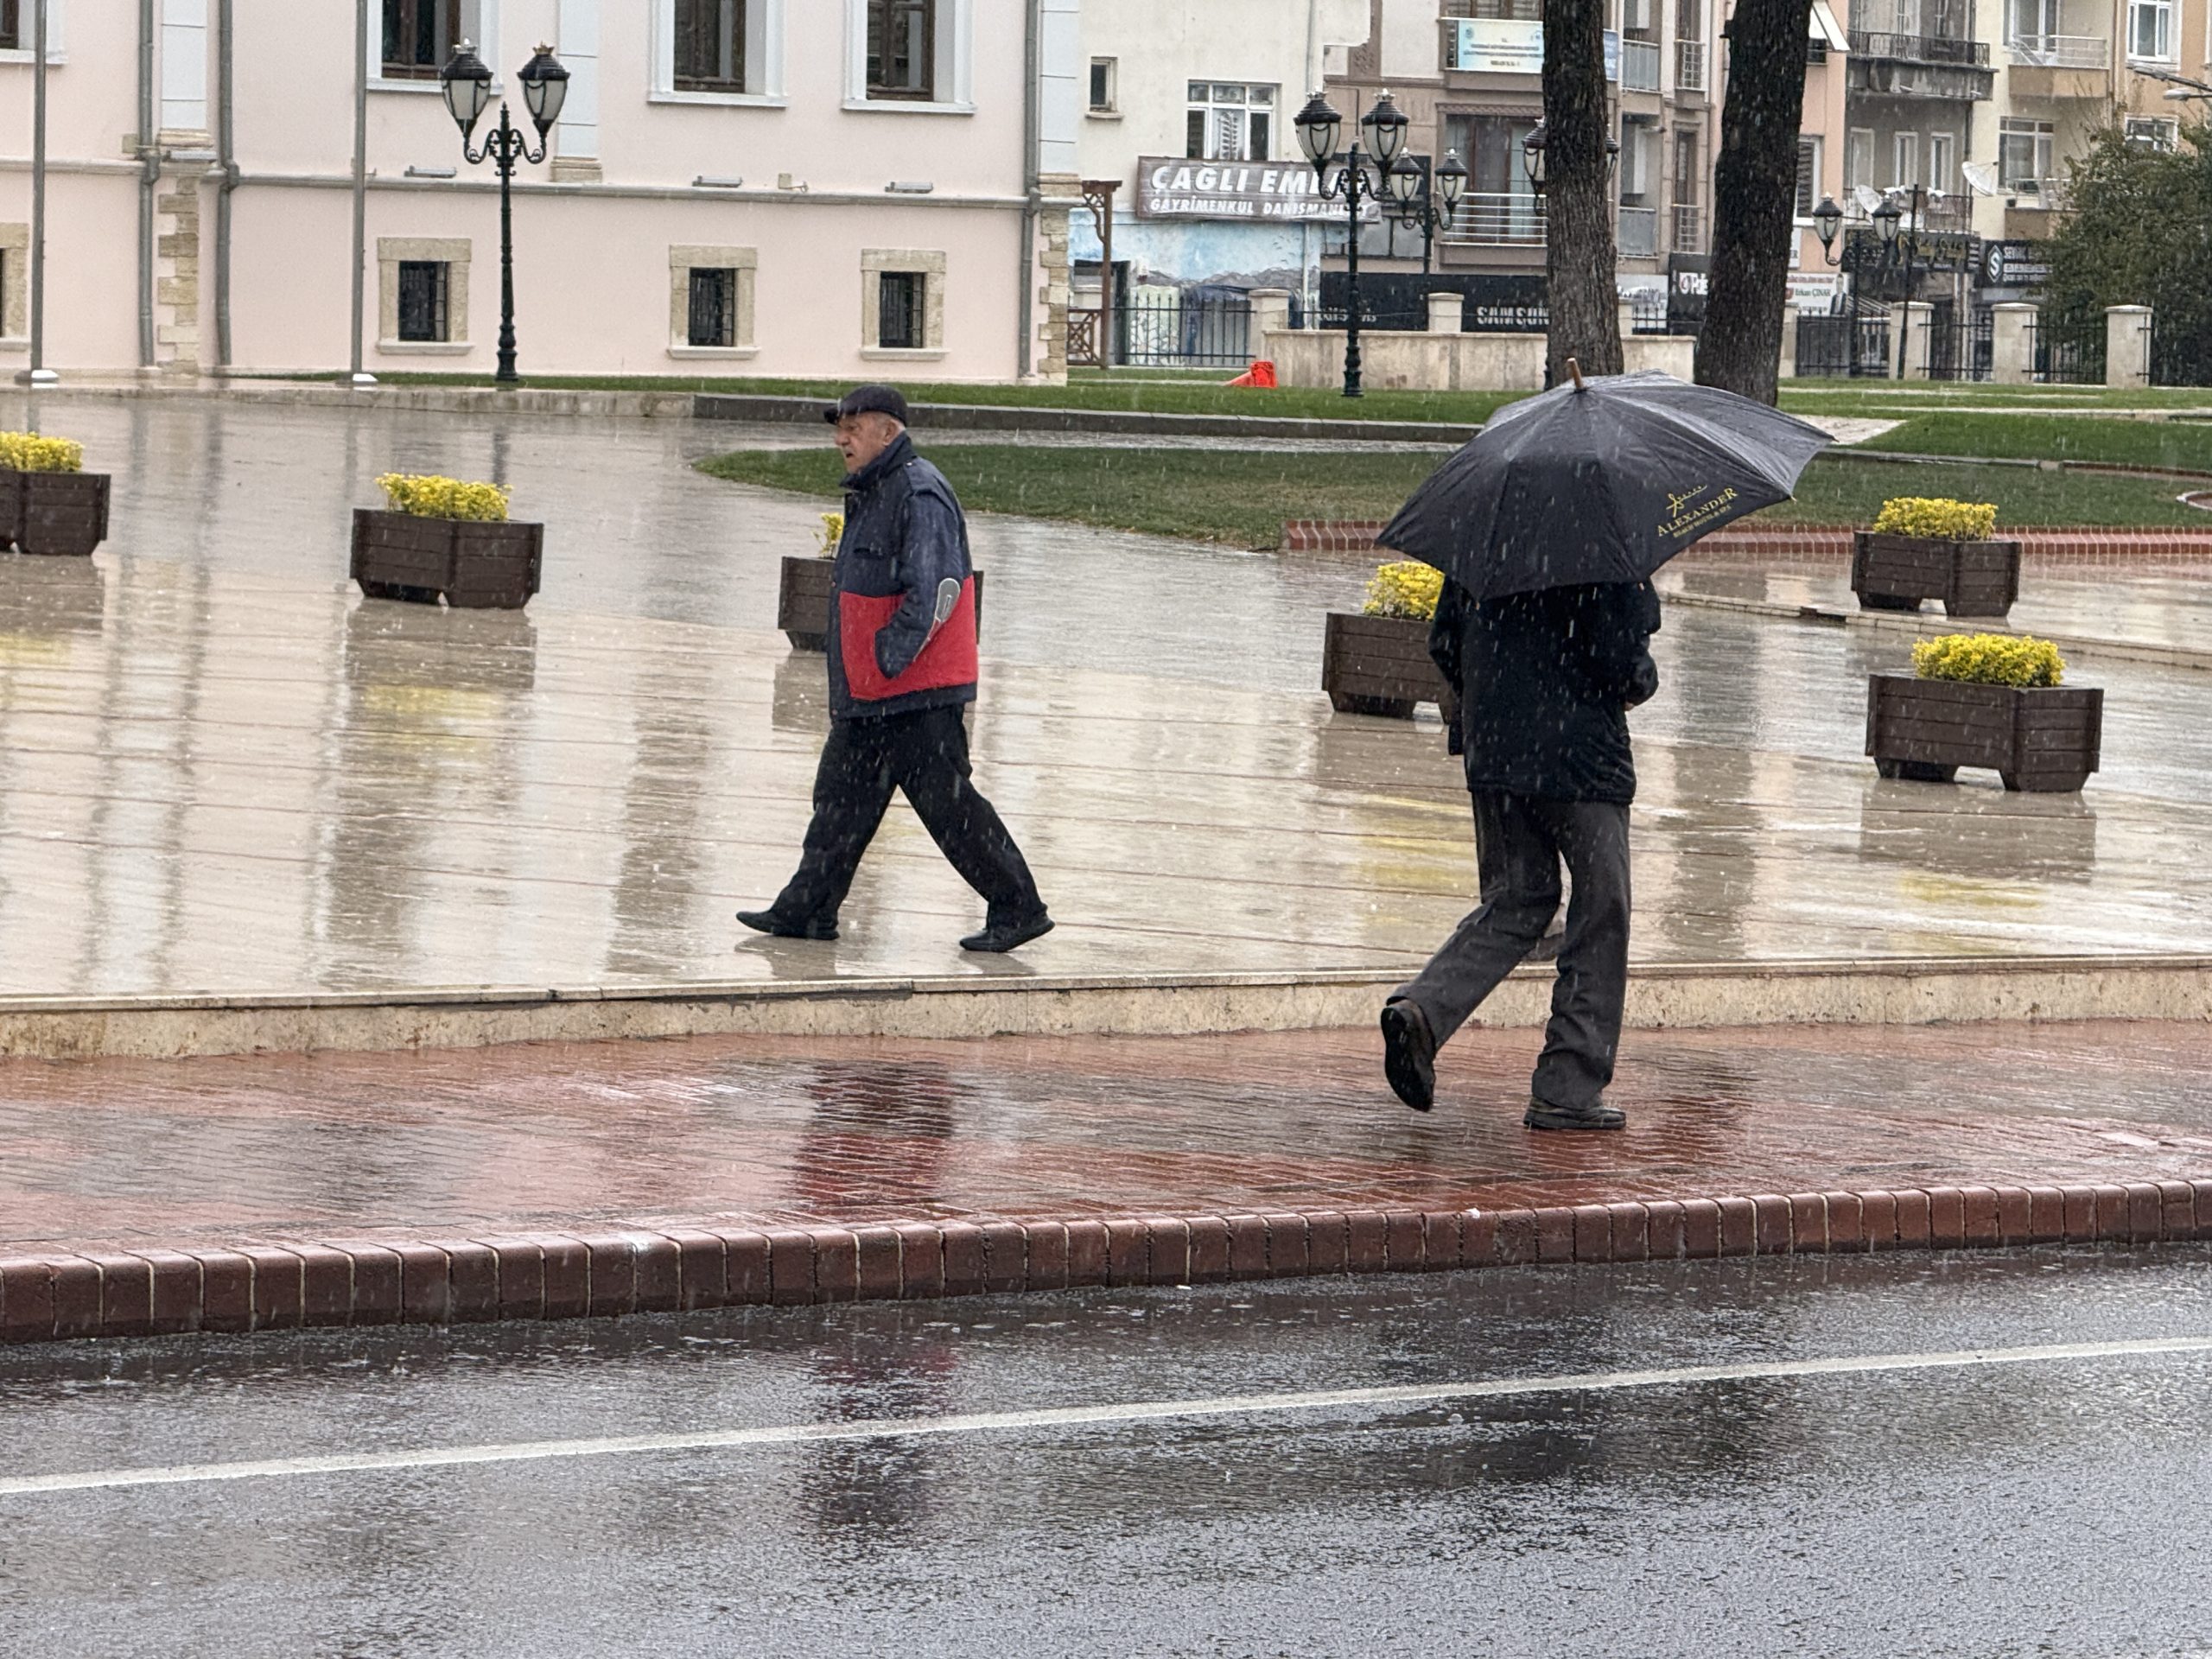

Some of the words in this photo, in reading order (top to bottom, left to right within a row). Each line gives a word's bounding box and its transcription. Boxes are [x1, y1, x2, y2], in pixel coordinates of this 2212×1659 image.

[1151, 162, 1249, 194] ÇAĞLI
[1150, 195, 1254, 214] GAYRİMENKUL
[1477, 306, 1549, 325] SAMSUN
[1656, 487, 1738, 537] ALEXANDER
